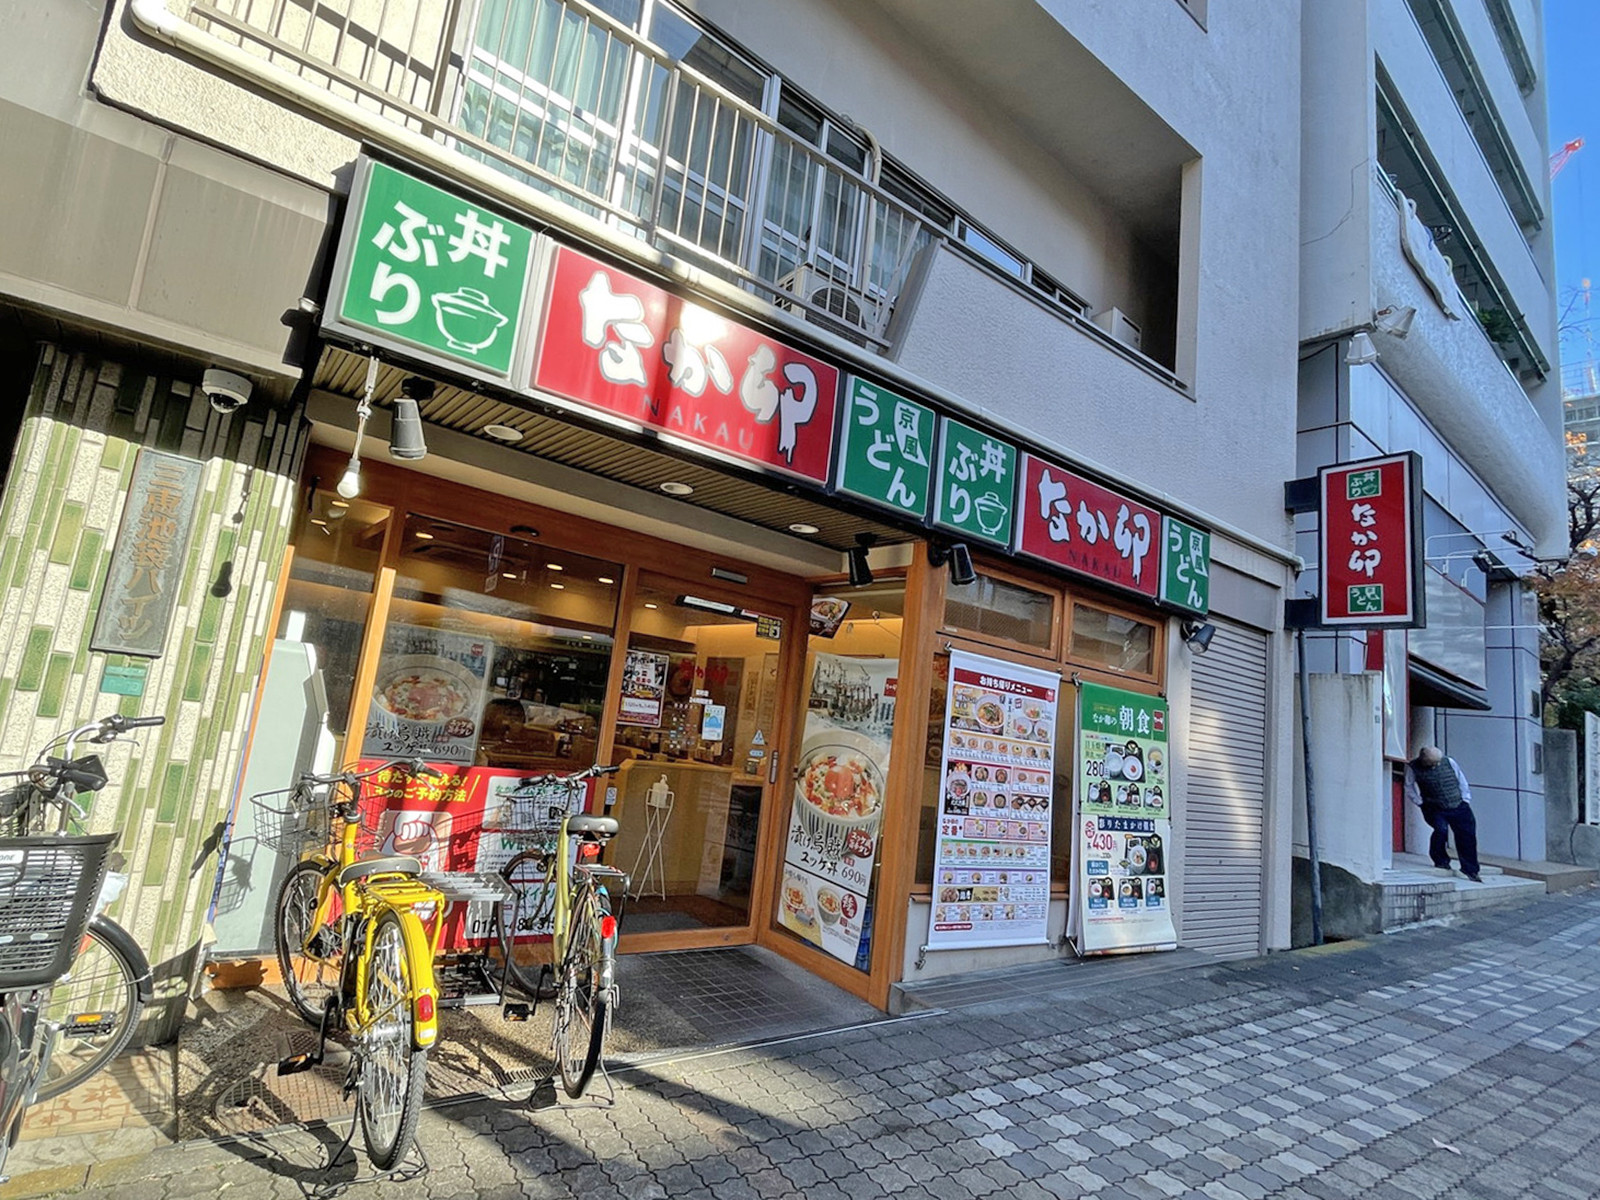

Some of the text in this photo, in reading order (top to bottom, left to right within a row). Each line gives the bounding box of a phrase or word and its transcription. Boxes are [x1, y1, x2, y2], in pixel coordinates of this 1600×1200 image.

[578, 269, 819, 465] なか卯
[639, 393, 755, 451] NAKAU
[854, 384, 917, 508] うどん
[1038, 467, 1152, 585] なか卯
[1348, 502, 1382, 579] なか卯
[1066, 549, 1124, 581] NAKAU
[1167, 523, 1203, 609] うどん
[979, 674, 1034, 694] お持ち帰りメニュー
[1118, 704, 1151, 735] 朝食
[1085, 760, 1105, 777] 280
[1092, 833, 1113, 851] 430
